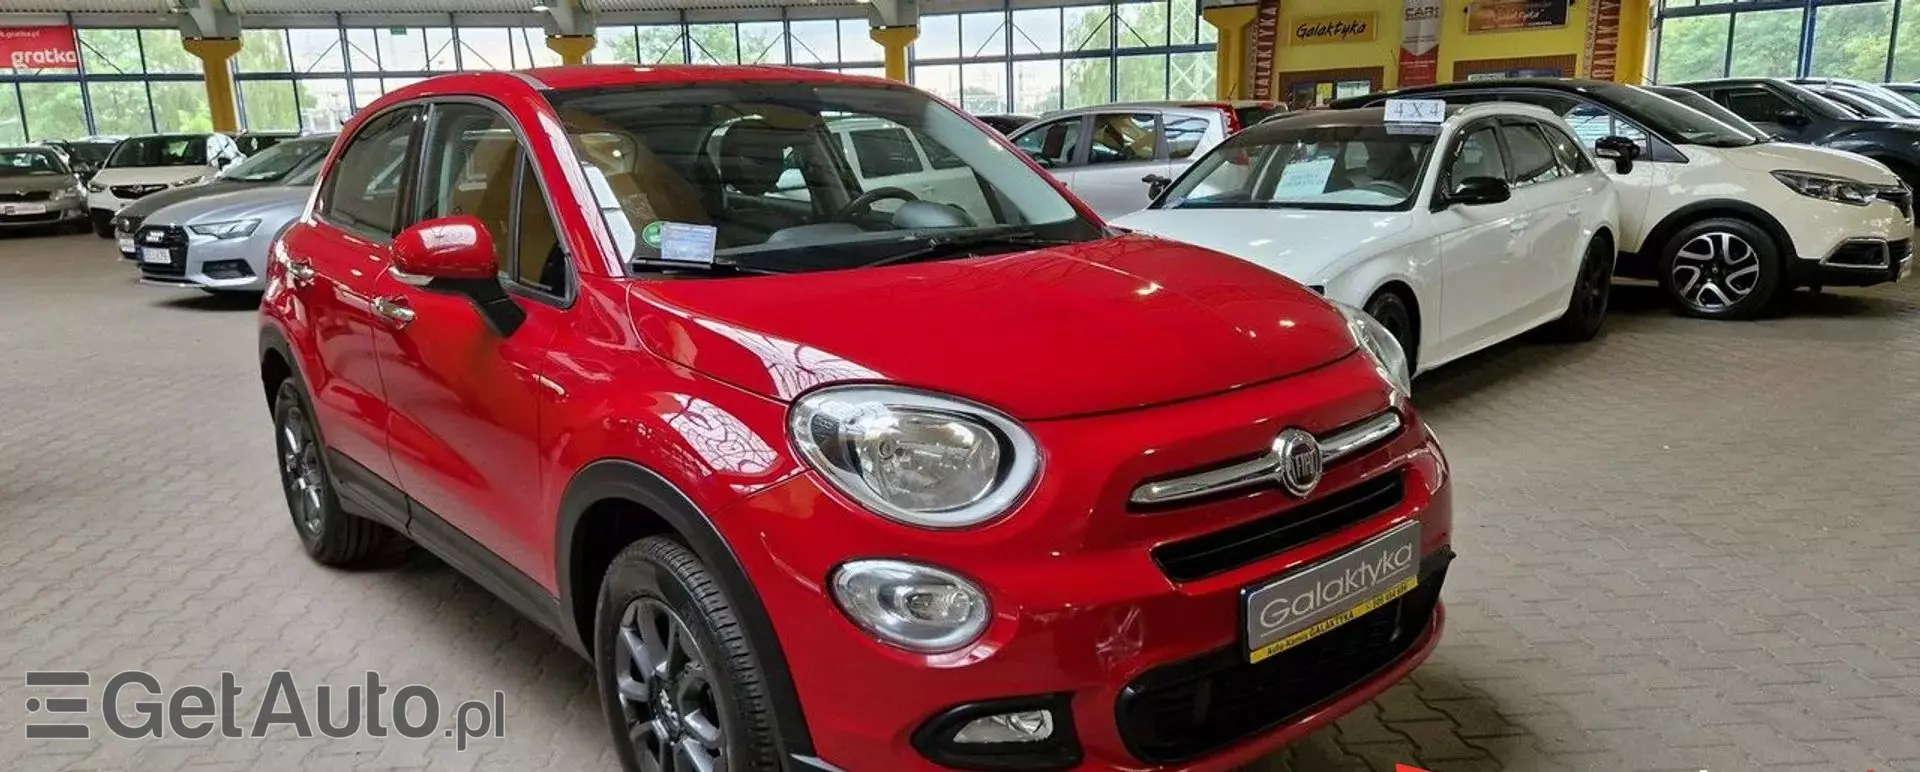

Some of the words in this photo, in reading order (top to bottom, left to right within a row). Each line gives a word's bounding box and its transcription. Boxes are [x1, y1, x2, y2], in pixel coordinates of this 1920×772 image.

[1296, 20, 1368, 38] Galaktyka
[11, 48, 77, 68] gratka
[1394, 102, 1404, 117] 4
[1430, 103, 1439, 117] 4
[1291, 449, 1318, 480] FIAT
[1259, 541, 1413, 628] Galaktyka
